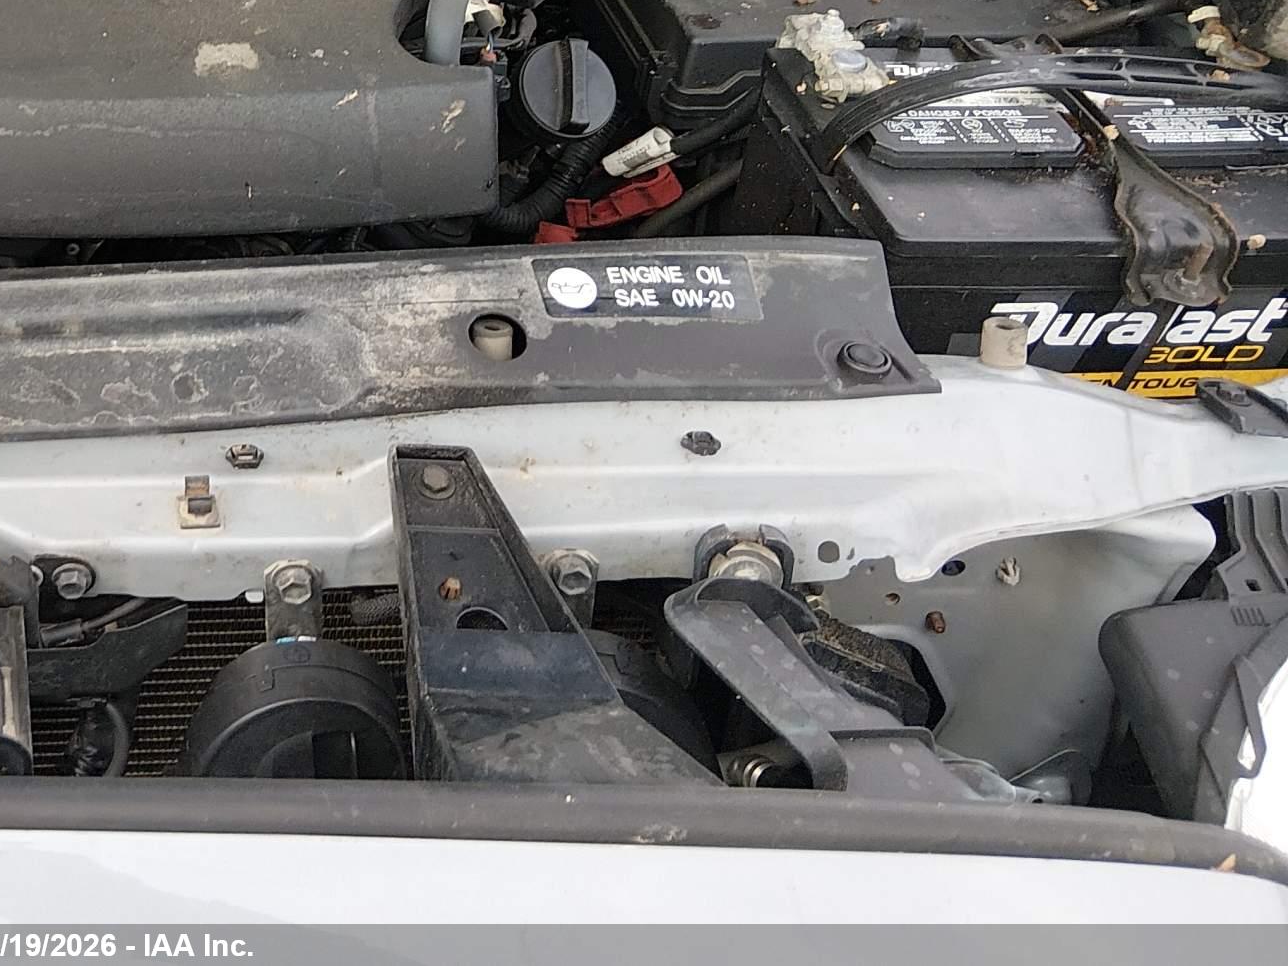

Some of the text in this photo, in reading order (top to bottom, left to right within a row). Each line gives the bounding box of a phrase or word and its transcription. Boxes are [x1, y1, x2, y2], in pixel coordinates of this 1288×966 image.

[605, 265, 731, 285] ENGINE OIL
[614, 288, 735, 310] SAE 0W-20
[1130, 377, 1199, 390] TOUG
